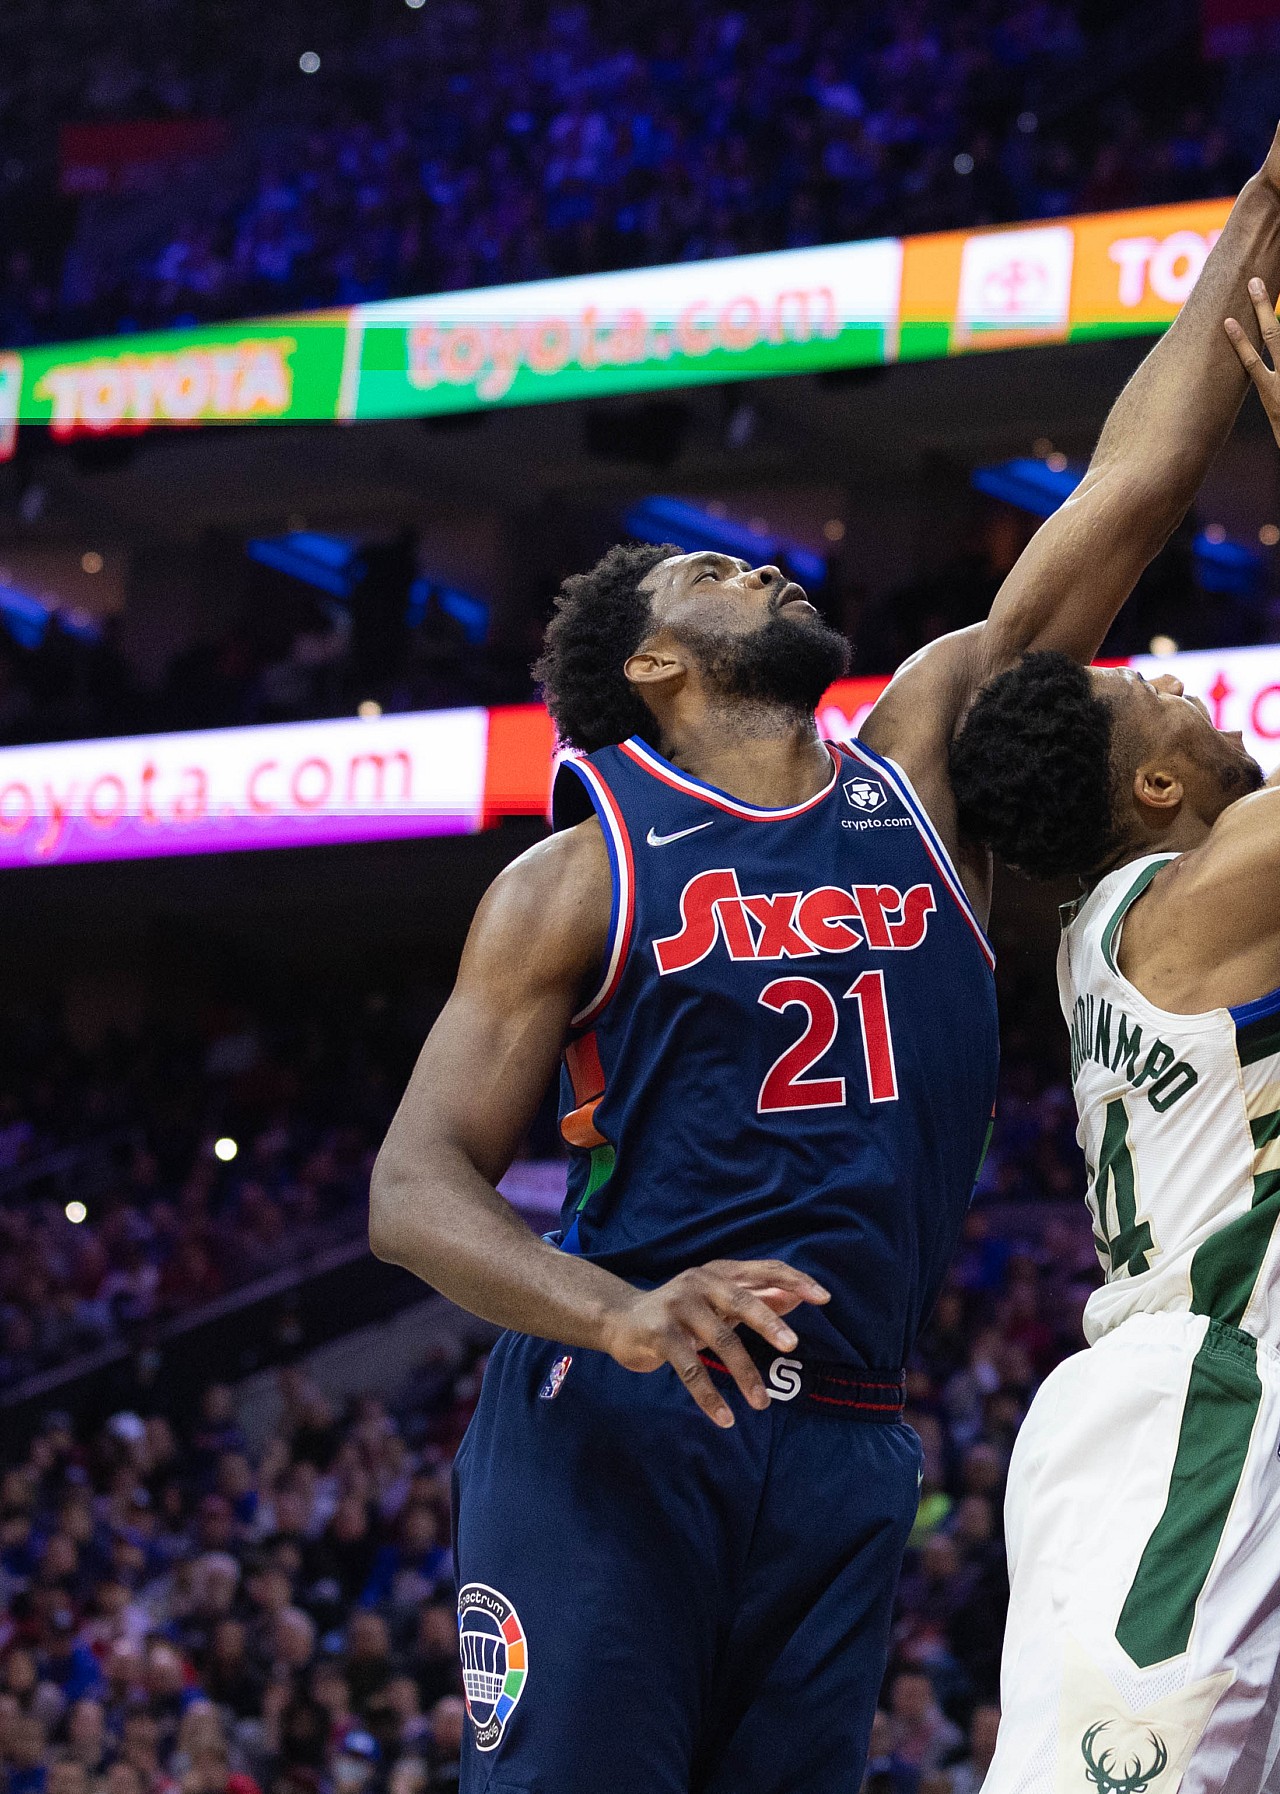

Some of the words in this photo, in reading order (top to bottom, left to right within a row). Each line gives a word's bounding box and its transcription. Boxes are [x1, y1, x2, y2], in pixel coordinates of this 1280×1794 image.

[36, 338, 296, 440] TOYOTA
[407, 286, 842, 402] toyota.com
[841, 815, 913, 831] crypto.com
[652, 868, 937, 976] Sixers
[757, 969, 899, 1114] 21
